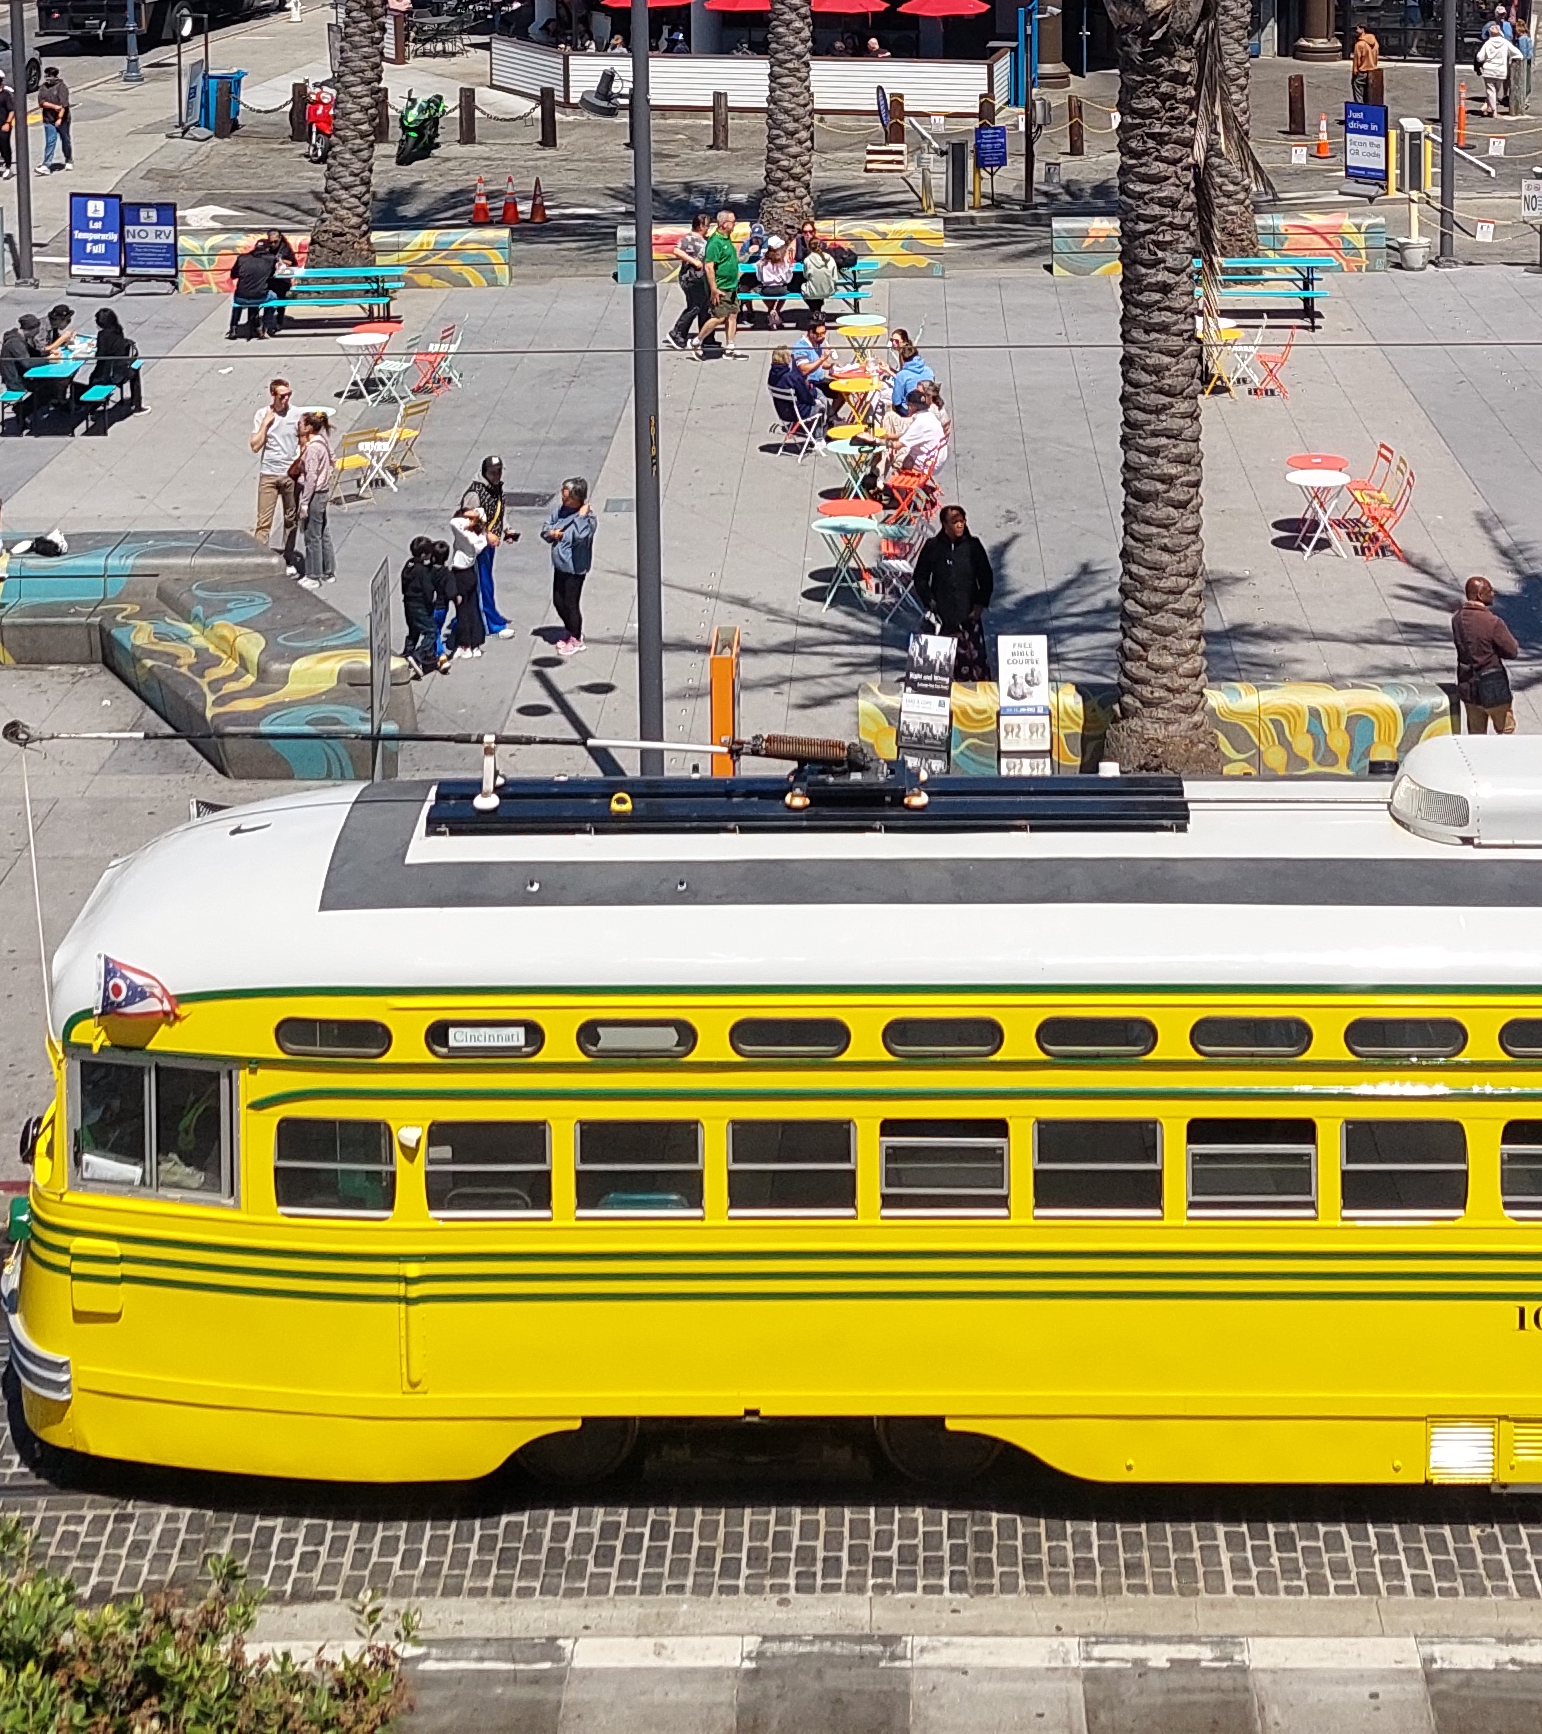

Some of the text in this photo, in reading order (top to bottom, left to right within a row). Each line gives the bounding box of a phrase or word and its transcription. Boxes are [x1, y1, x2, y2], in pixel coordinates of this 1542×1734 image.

[1347, 109, 1364, 120] Just
[1348, 121, 1378, 132] drive in
[1523, 194, 1538, 212] NO
[73, 230, 119, 243] Temporarily
[126, 228, 172, 240] NO RV
[86, 242, 106, 254] Full
[453, 1030, 520, 1043] Cincinnati
